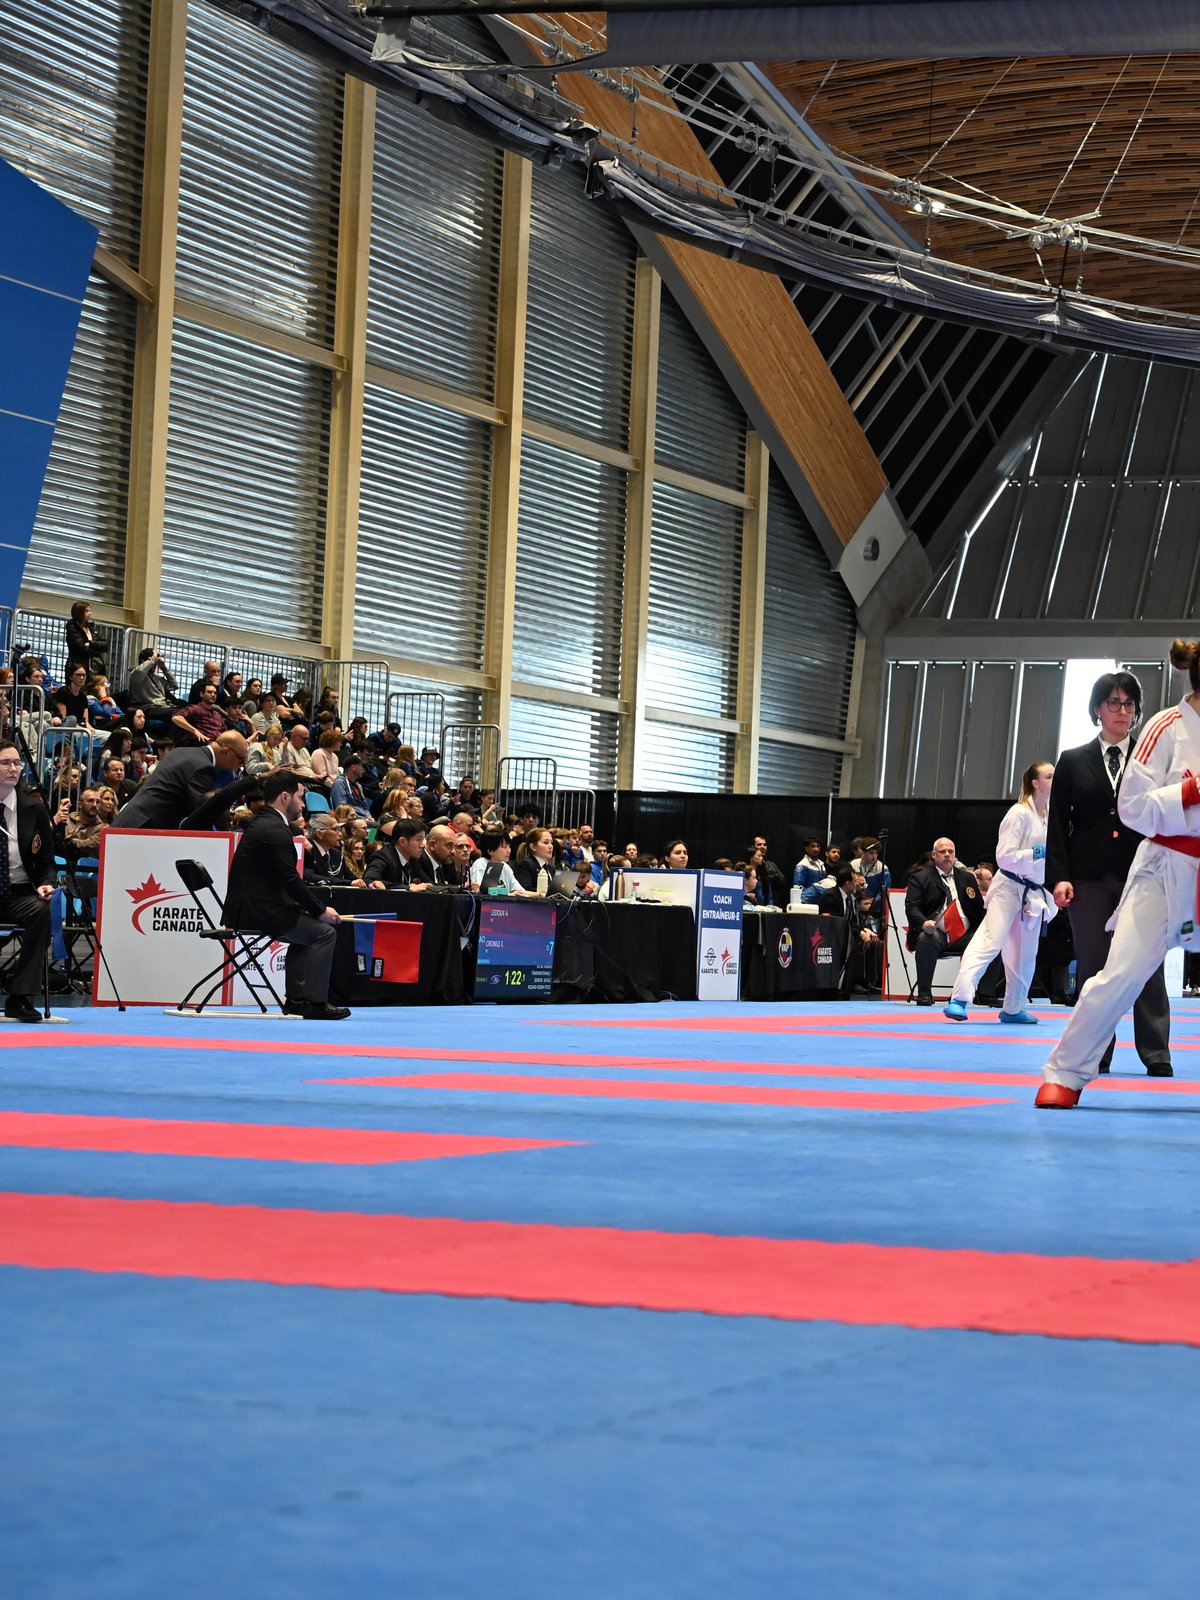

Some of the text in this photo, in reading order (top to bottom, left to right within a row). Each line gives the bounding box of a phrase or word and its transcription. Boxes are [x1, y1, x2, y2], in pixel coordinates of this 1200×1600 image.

[713, 894, 732, 905] COACH
[153, 906, 204, 919] KARATE
[152, 919, 204, 932] CANADA
